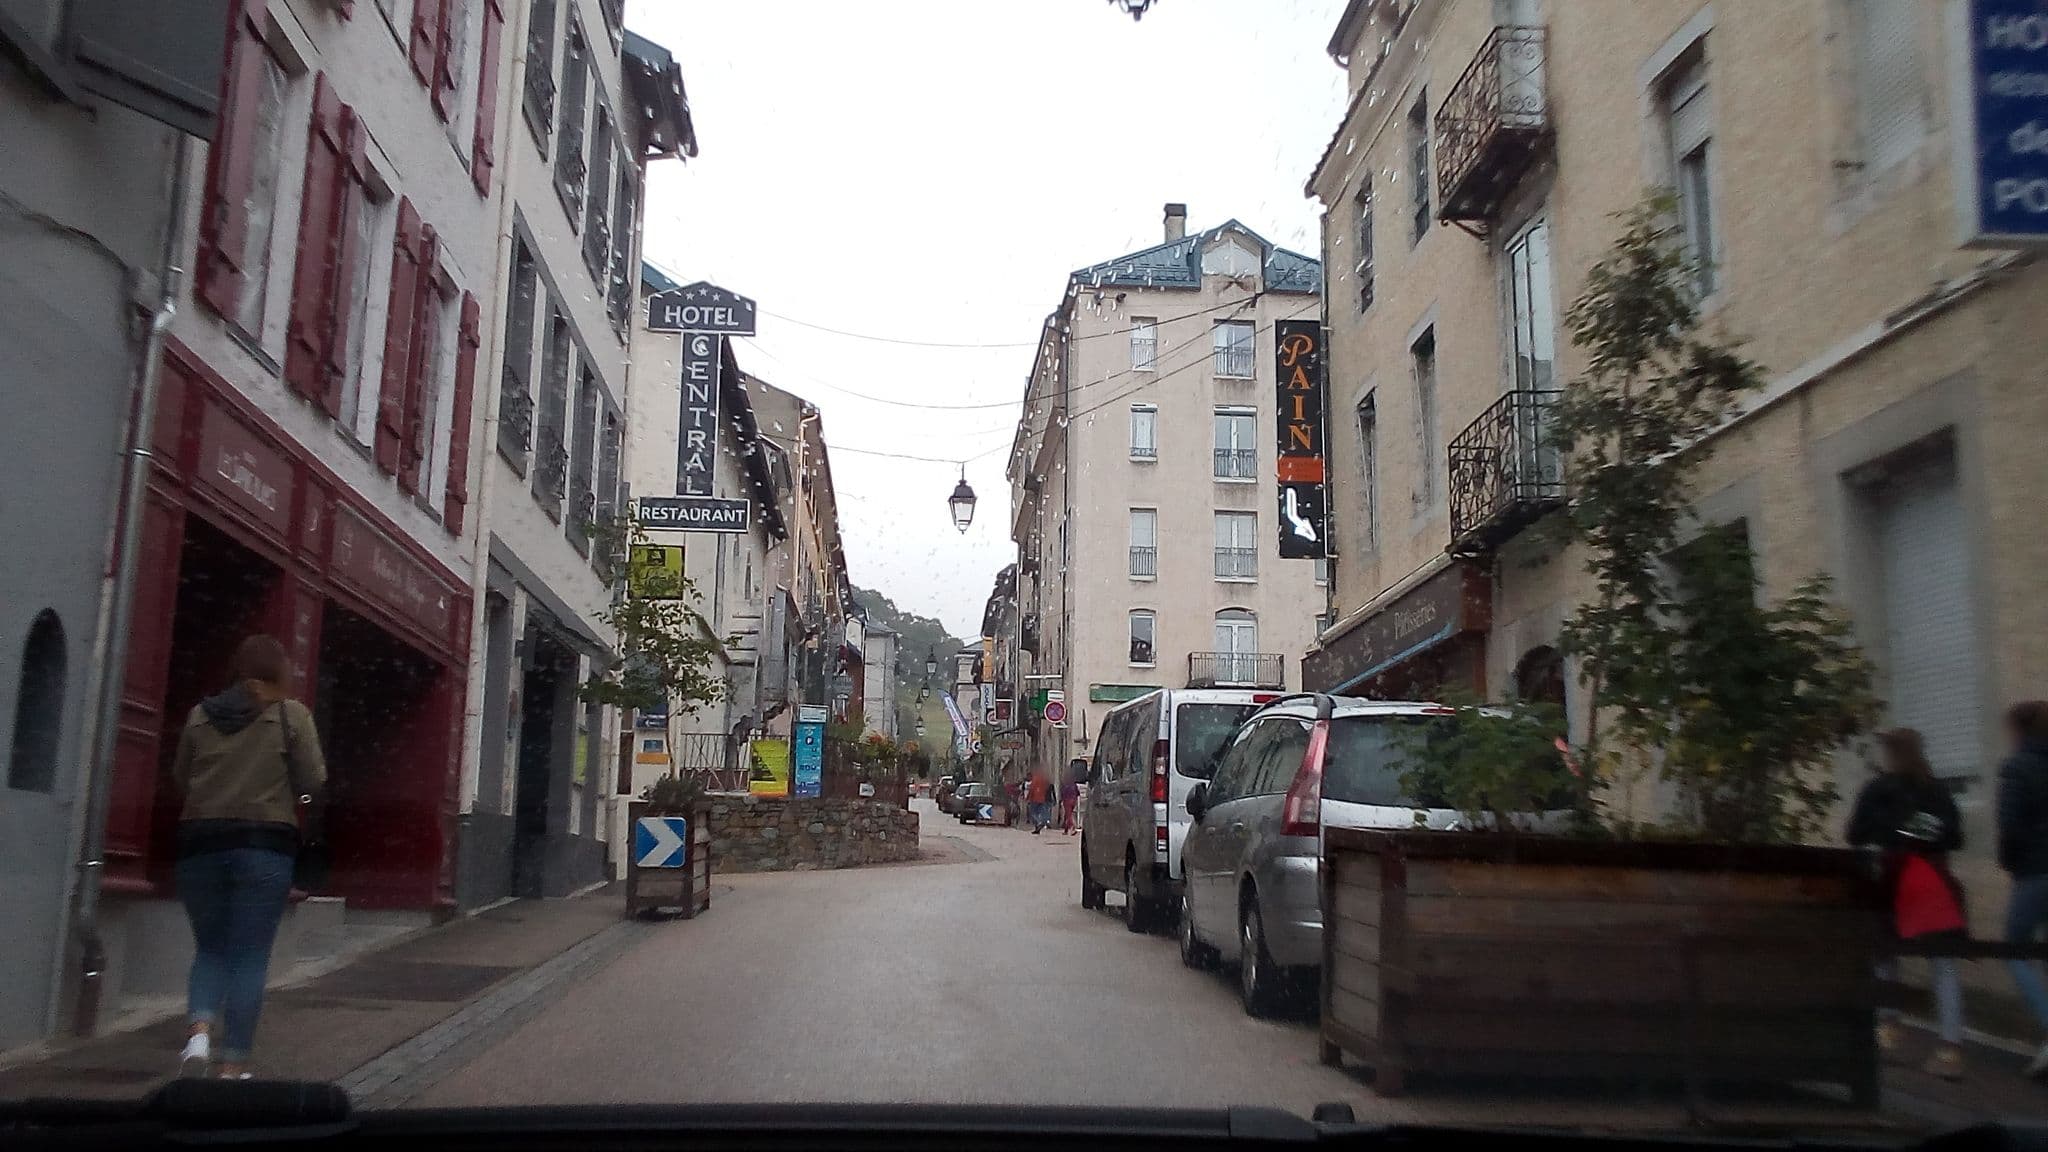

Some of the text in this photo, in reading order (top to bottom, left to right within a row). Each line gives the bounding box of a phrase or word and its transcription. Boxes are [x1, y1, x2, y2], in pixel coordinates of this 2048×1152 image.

[664, 304, 740, 327] HOTEL
[686, 334, 710, 495] CENTRAL
[1283, 333, 1314, 450] PAIN
[640, 506, 746, 524] RESTAURANT
